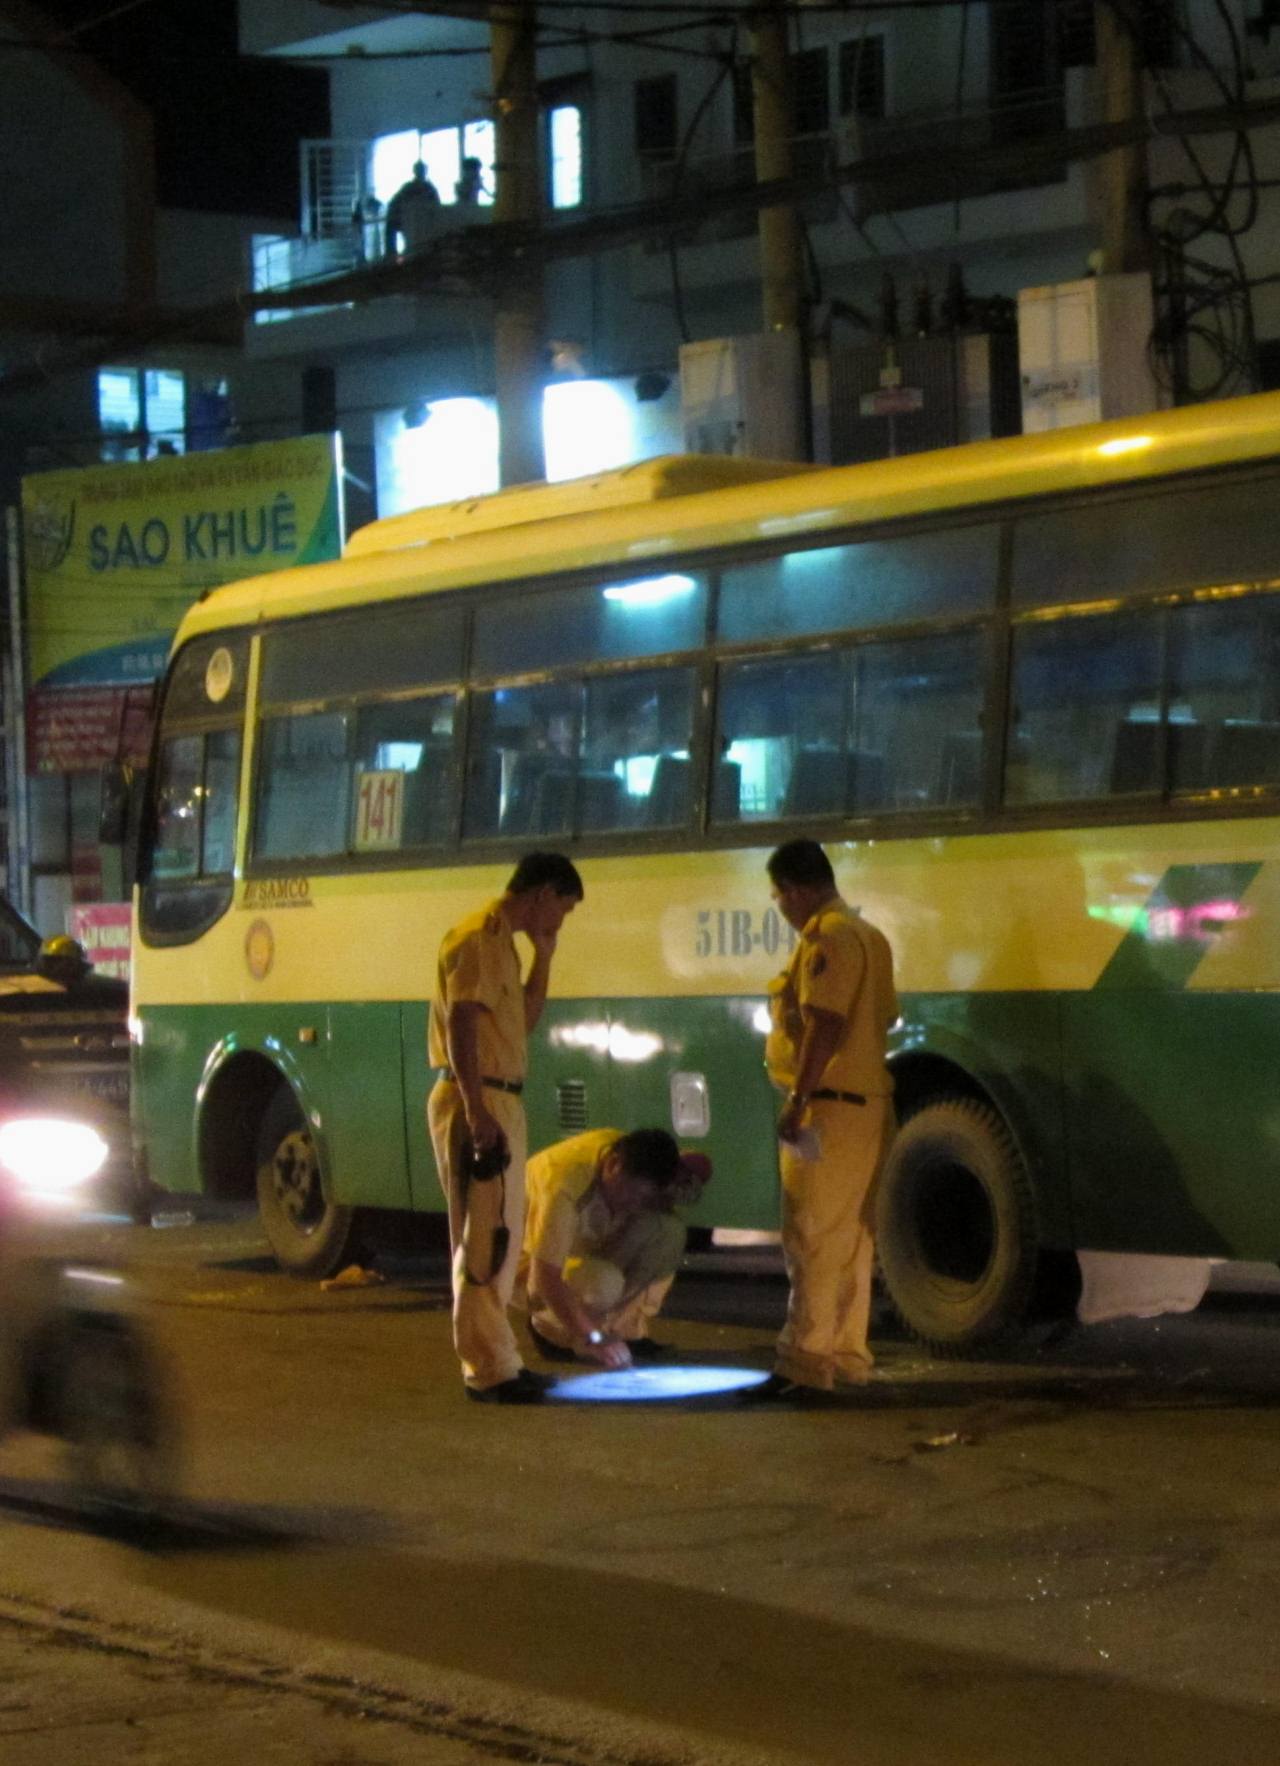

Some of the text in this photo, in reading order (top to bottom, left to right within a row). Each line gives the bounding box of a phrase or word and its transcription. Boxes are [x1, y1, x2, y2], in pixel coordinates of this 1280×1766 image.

[88, 490, 297, 572] SAO KHUÊ
[361, 777, 397, 841] 141
[258, 876, 310, 899] SAMCO
